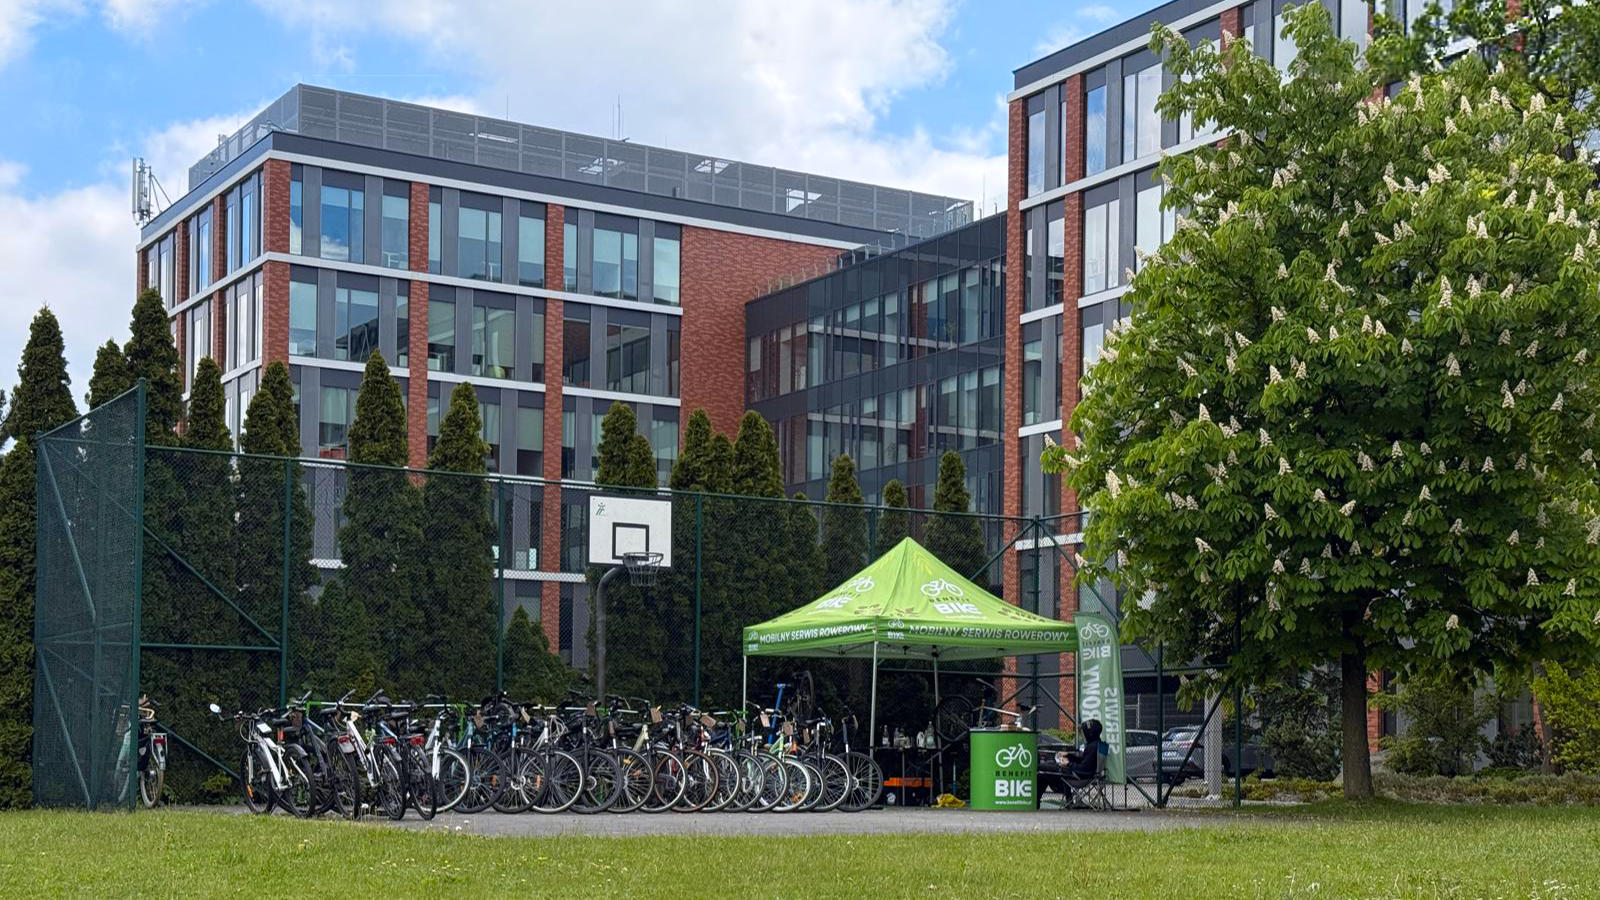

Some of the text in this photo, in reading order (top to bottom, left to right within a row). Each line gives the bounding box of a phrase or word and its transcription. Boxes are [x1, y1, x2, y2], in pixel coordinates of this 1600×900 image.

[934, 602, 981, 614] BIKE
[760, 624, 868, 643] MOBILNY SERWIS ROWEROWY
[909, 625, 1069, 641] MOBILNY SERWIS ROWEROWY
[995, 780, 1032, 797] BIKE
